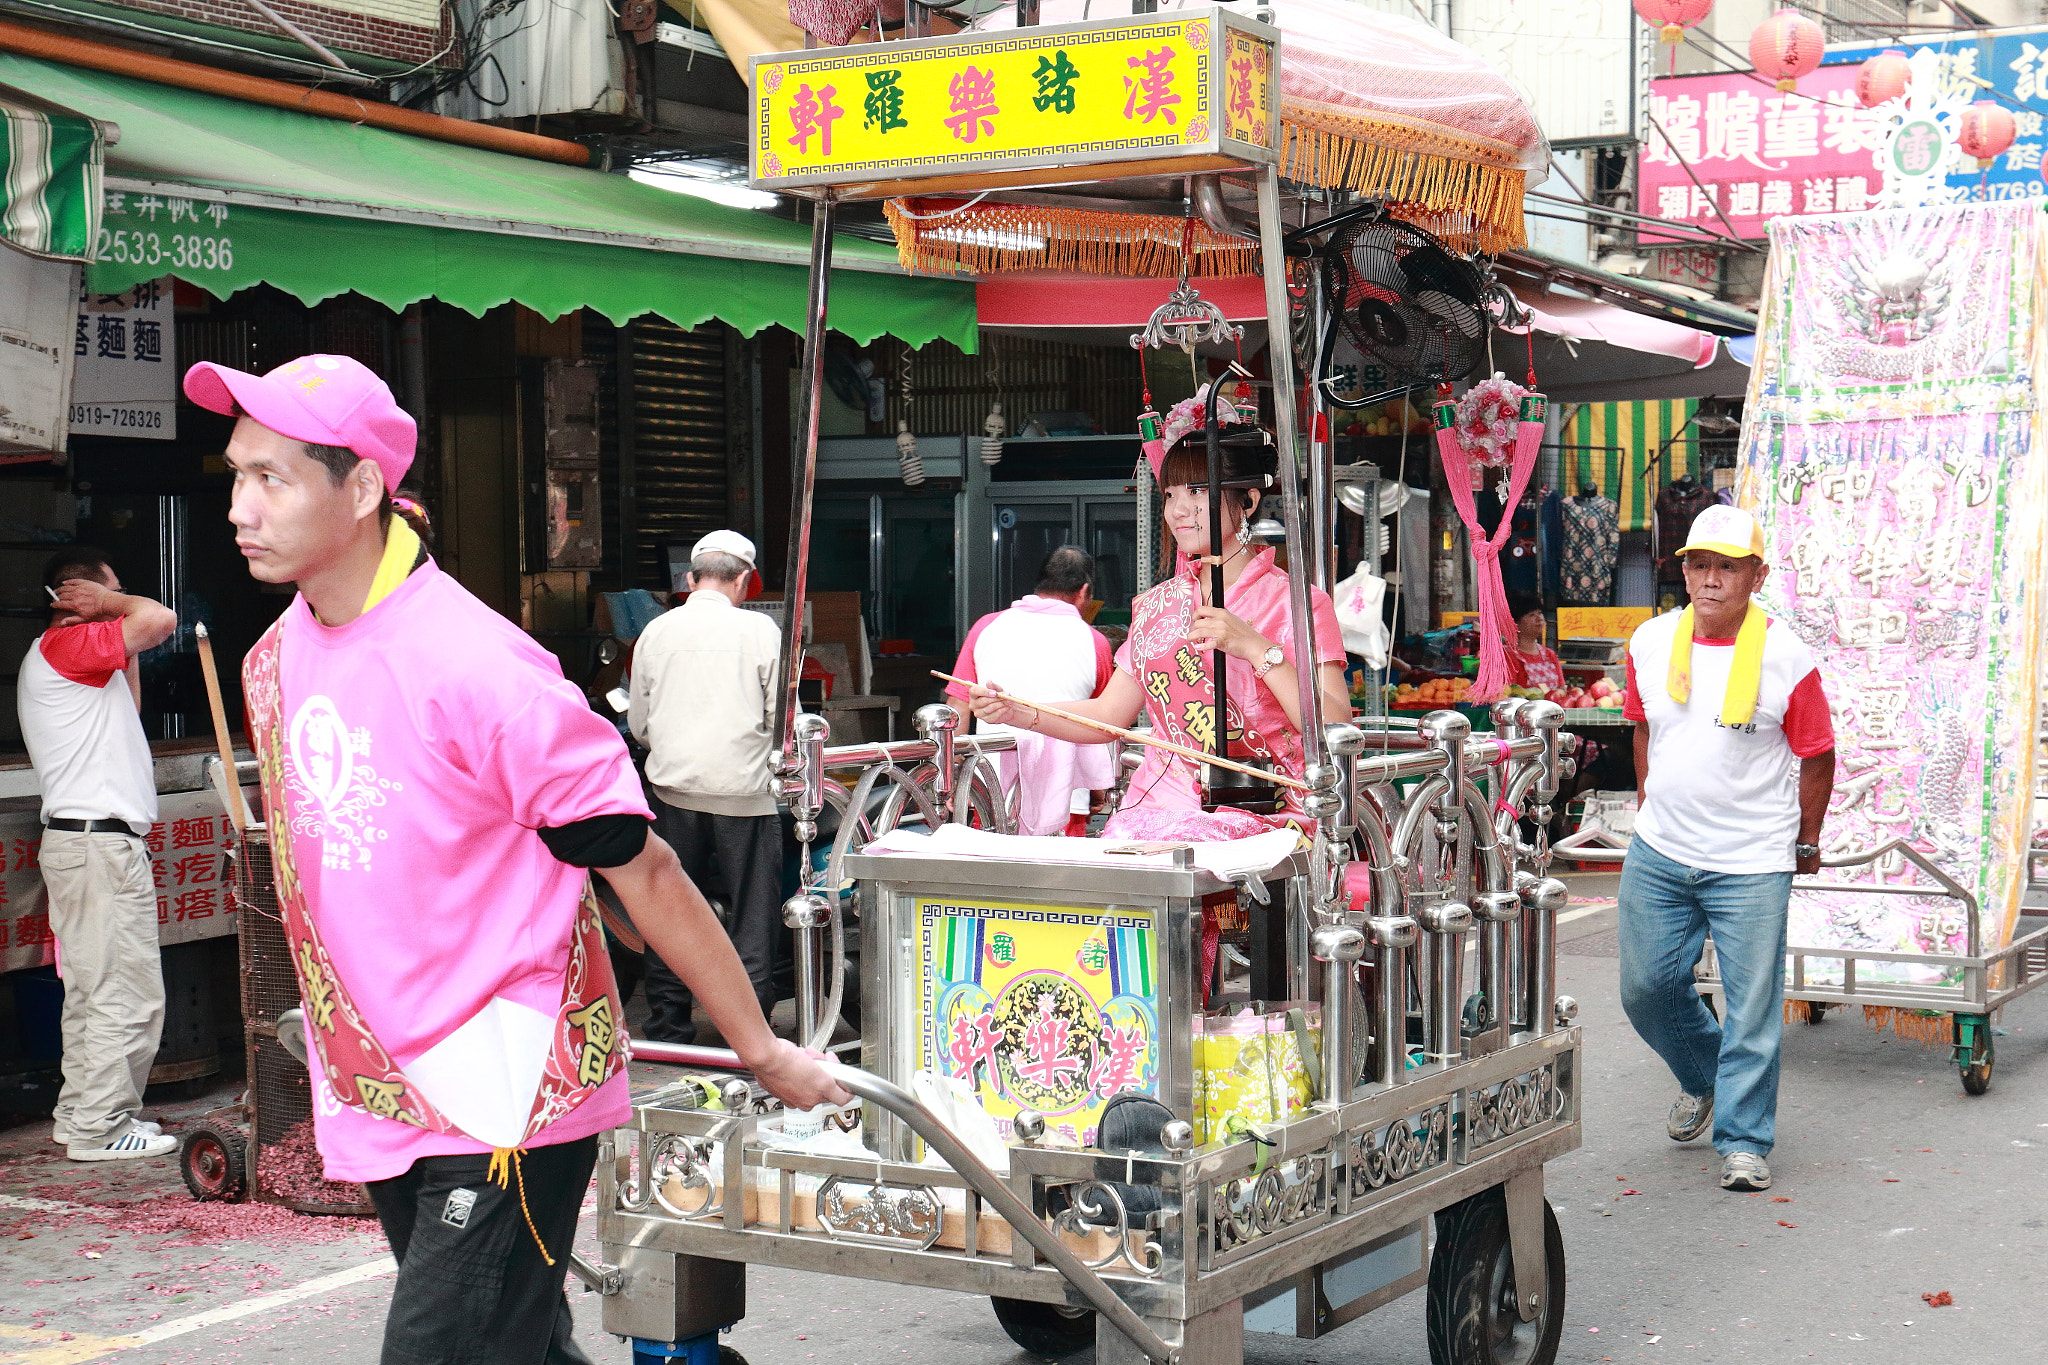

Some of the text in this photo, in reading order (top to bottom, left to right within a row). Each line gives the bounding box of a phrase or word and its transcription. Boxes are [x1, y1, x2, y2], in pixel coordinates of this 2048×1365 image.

[1229, 58, 1254, 126] 漢
[1898, 125, 1939, 171] 雷
[99, 228, 233, 271] 2533-3836
[69, 405, 161, 429] 0919-726326
[172, 816, 217, 922] 麵疙瘩
[991, 934, 1109, 969] 諸 羅
